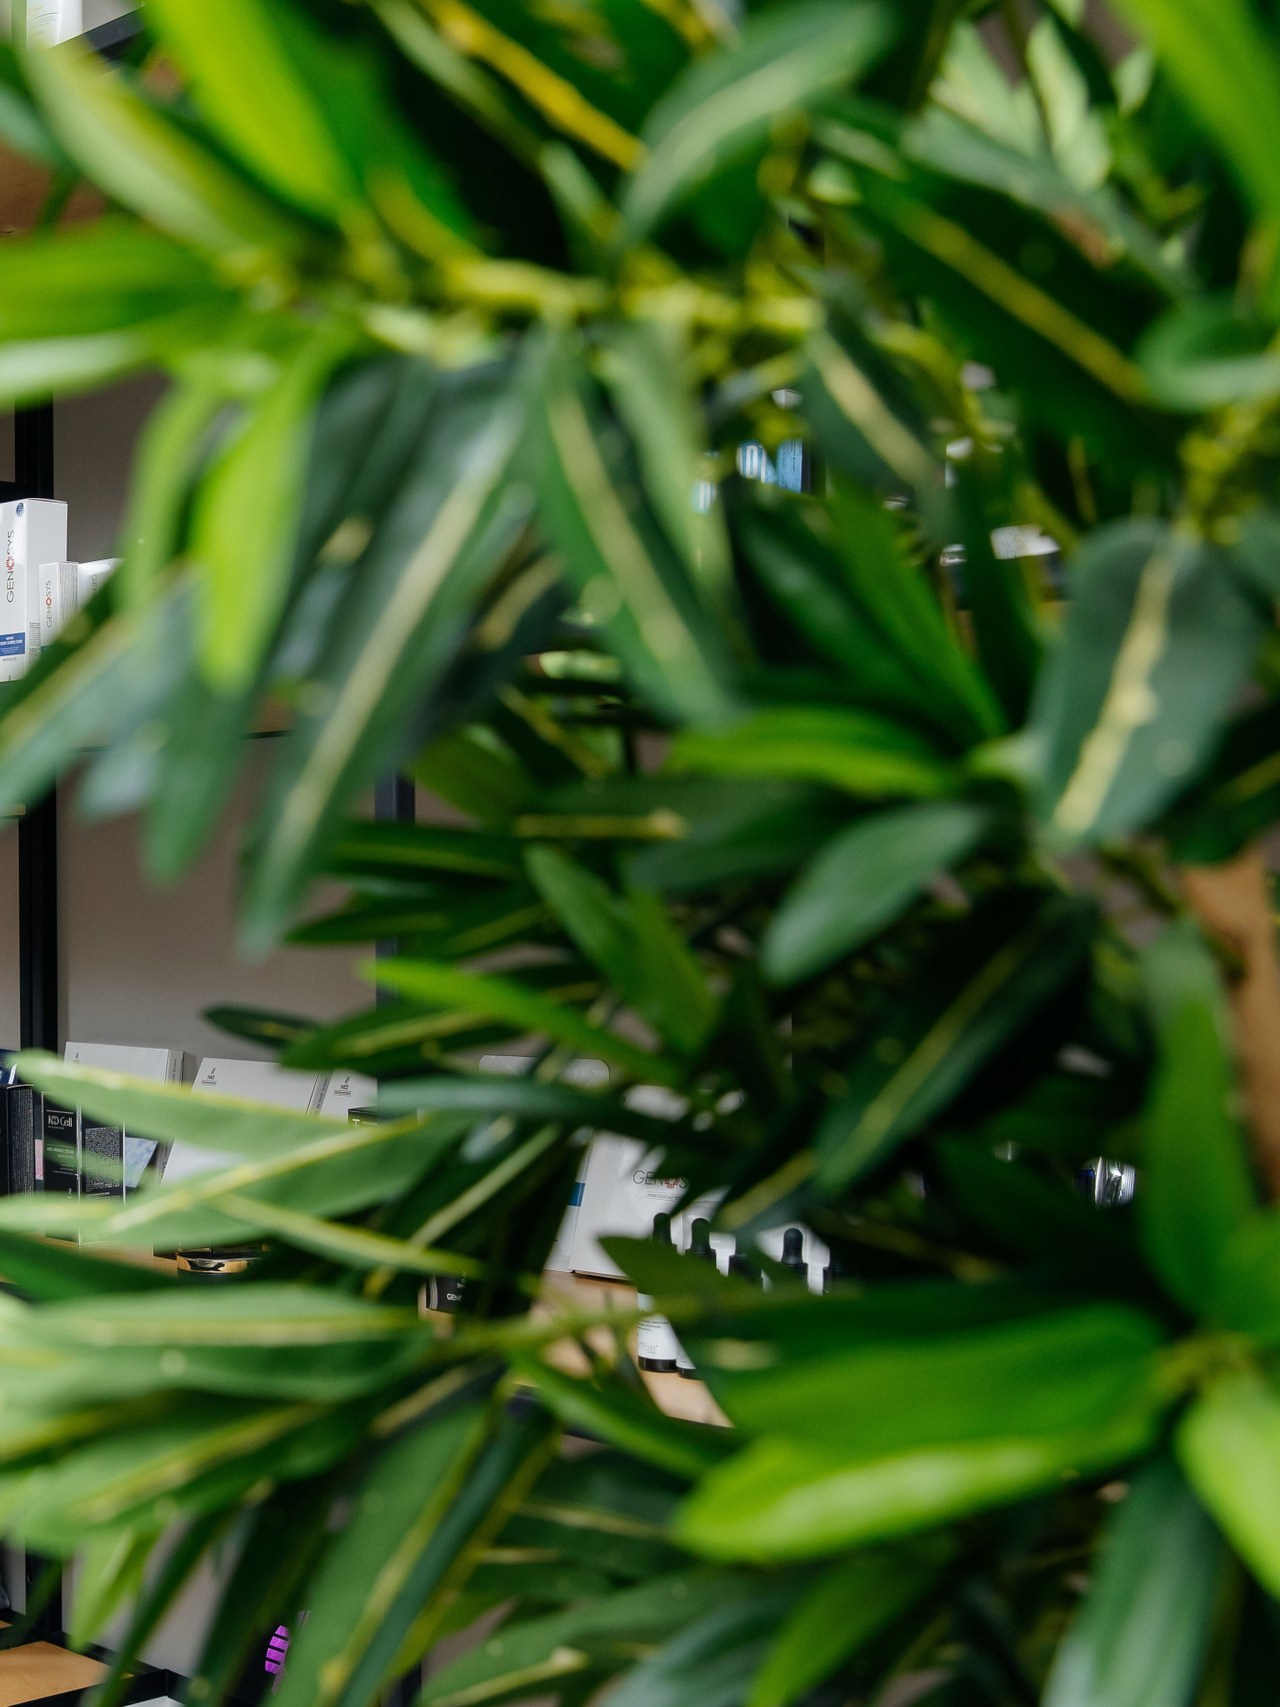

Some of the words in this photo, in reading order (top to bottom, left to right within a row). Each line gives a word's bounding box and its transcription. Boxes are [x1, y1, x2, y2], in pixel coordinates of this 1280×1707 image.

[5, 529, 15, 603] GENOSYS
[59, 1116, 73, 1128] Cell
[632, 1169, 688, 1189] GENOS
